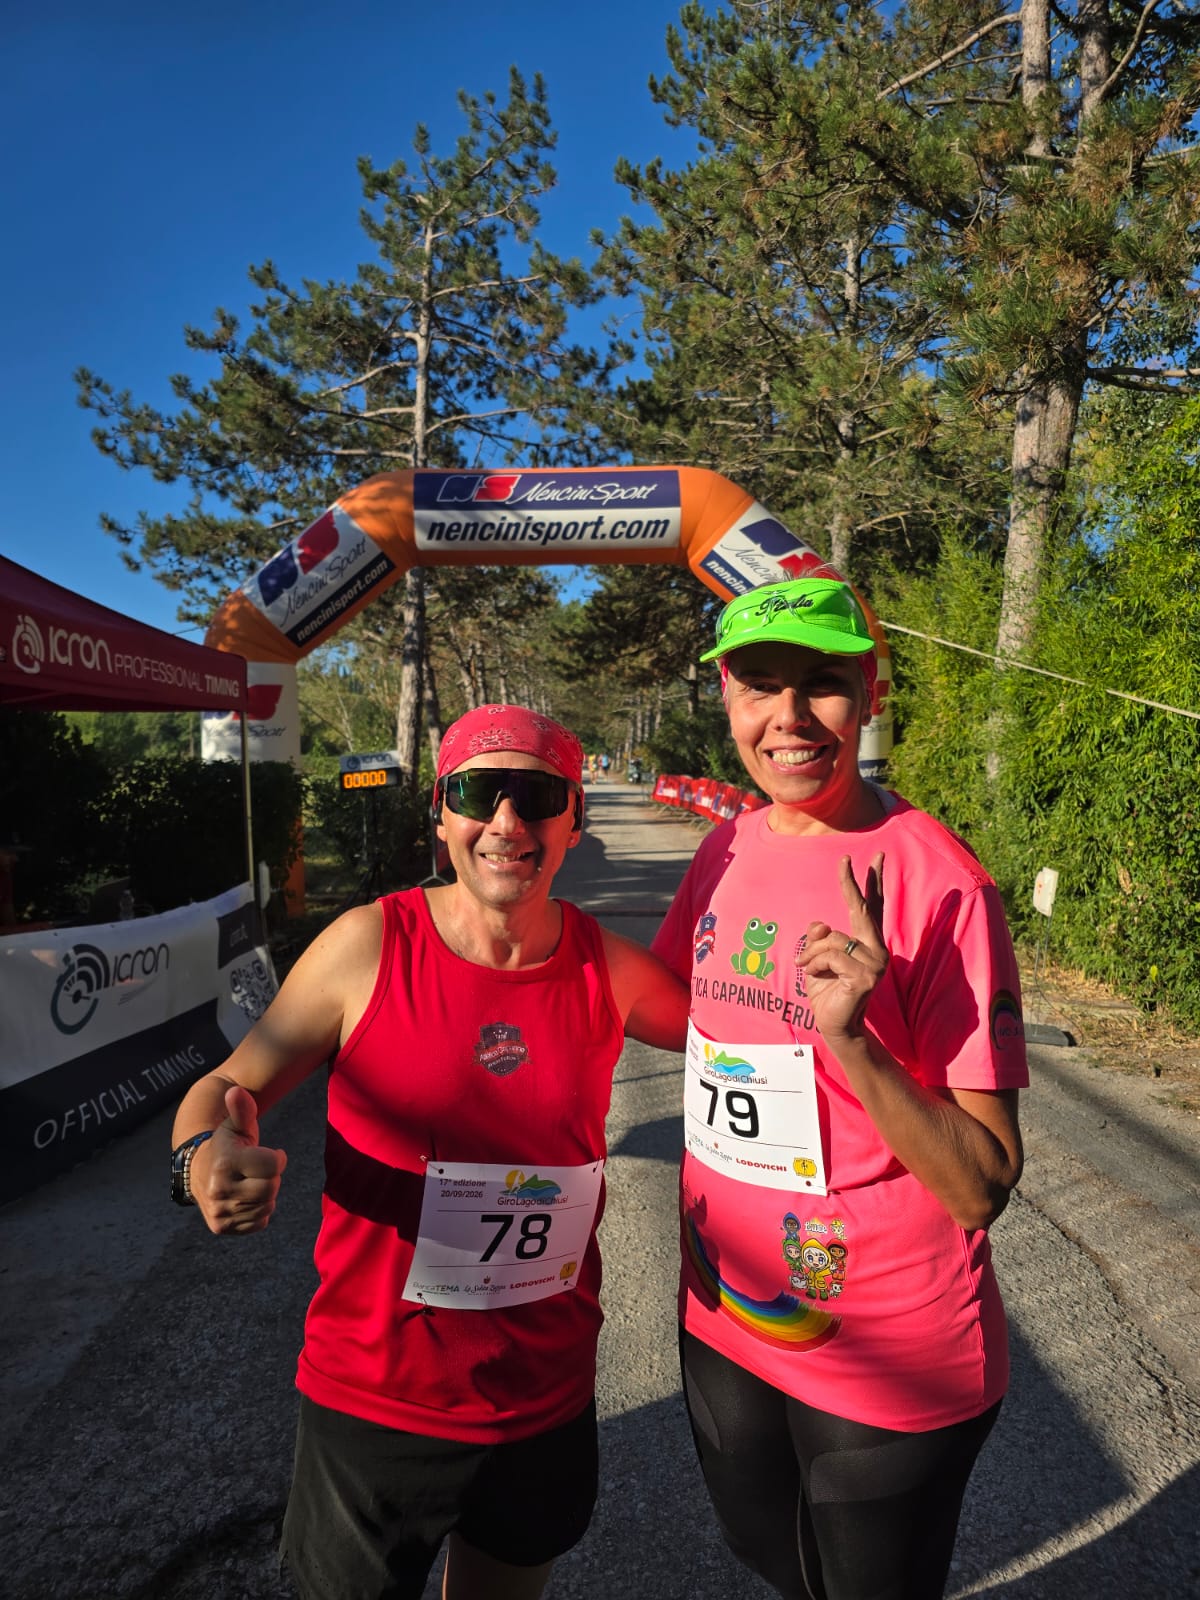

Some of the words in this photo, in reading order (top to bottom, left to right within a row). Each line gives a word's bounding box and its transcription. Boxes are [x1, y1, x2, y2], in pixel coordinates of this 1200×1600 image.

[426, 515, 671, 545] nencinisport.com
[297, 559, 389, 642] nencinisport.com
[114, 653, 204, 692] PROFESSIONAL
[204, 674, 239, 697] TIMING
[34, 1079, 146, 1149] OFFICIAL
[141, 1045, 206, 1091] TIMING
[699, 1078, 760, 1139] 79
[453, 1178, 487, 1187] edizione
[735, 1157, 788, 1172] LODOVICHI
[440, 1190, 484, 1199] 20/09/2026
[479, 1213, 553, 1263] 78
[510, 1275, 555, 1290] LODOVICHI
